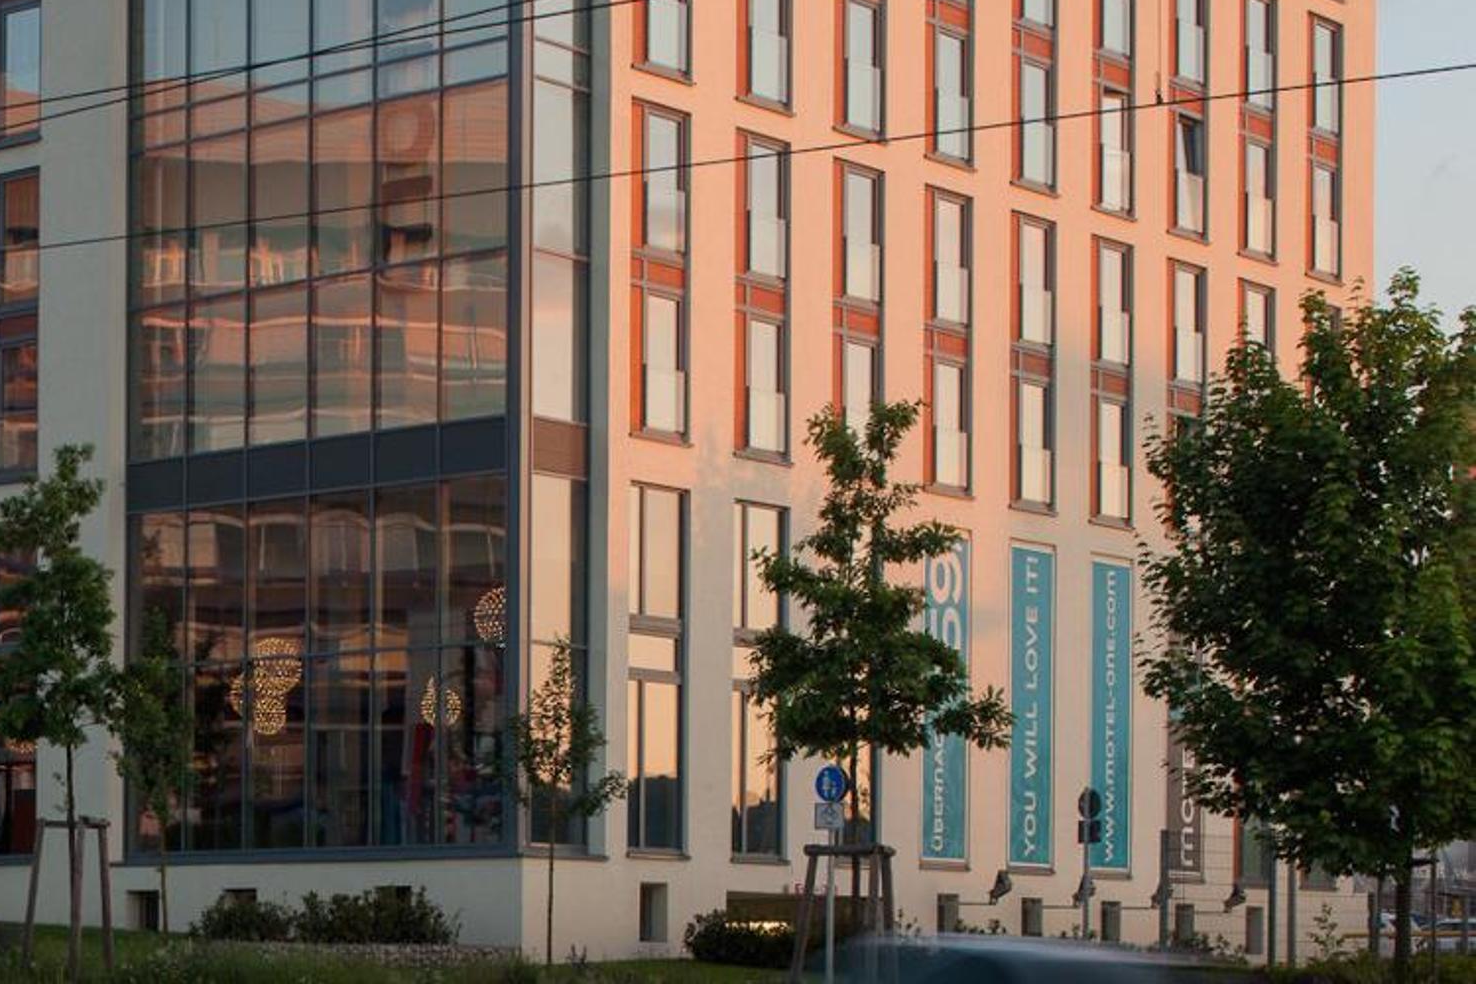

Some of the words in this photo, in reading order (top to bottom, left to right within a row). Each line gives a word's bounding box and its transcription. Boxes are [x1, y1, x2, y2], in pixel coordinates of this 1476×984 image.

[1024, 606, 1039, 690] LOVE
[1024, 700, 1038, 779] WILL
[1024, 791, 1037, 857] YOU
